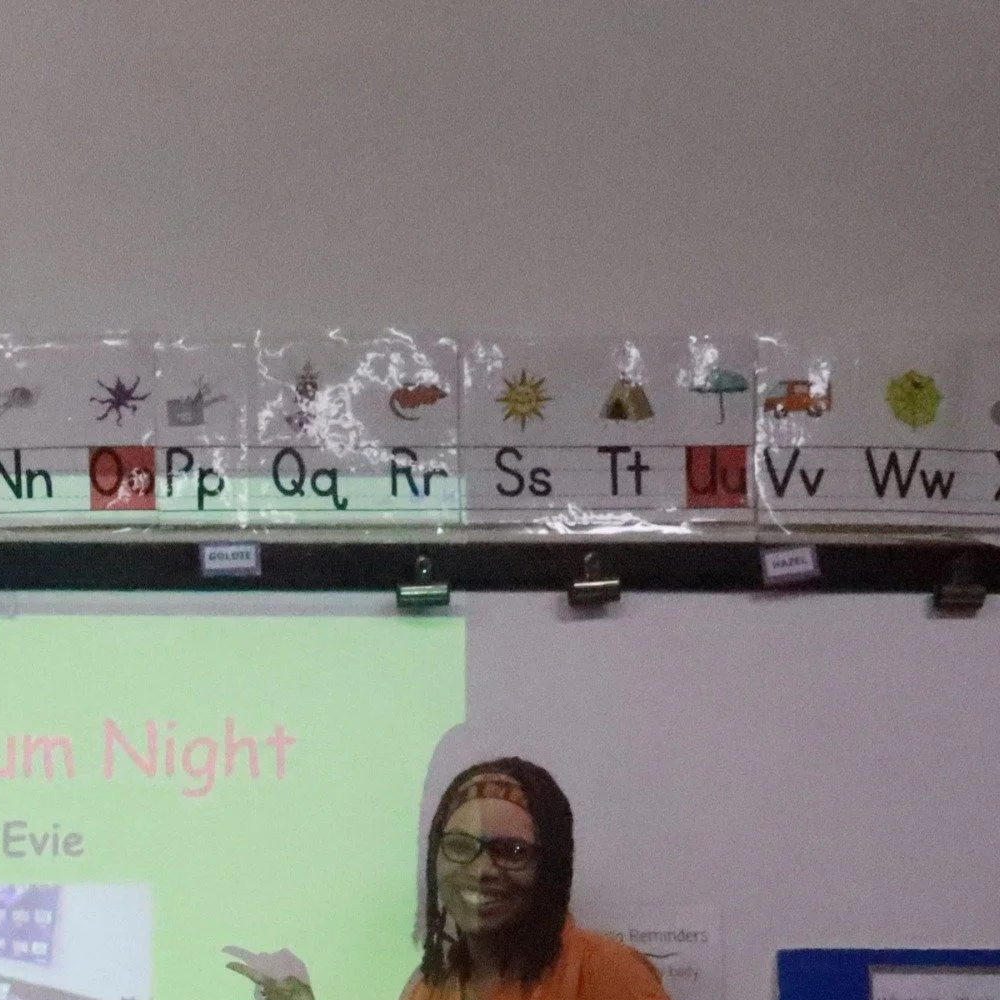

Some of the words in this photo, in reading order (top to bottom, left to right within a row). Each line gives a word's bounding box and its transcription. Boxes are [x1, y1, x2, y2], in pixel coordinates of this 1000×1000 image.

[89, 447, 154, 496] Oo
[166, 447, 225, 510] Pp
[272, 447, 348, 510] Qq
[390, 447, 448, 497] Rr
[495, 446, 552, 497] Ss
[598, 446, 650, 496] Tt
[687, 446, 747, 496] Uu
[764, 447, 825, 497] Vv
[866, 447, 955, 499] Ww
[103, 716, 297, 798] Night
[2, 820, 85, 858] Evie
[628, 929, 709, 943] Reminders
